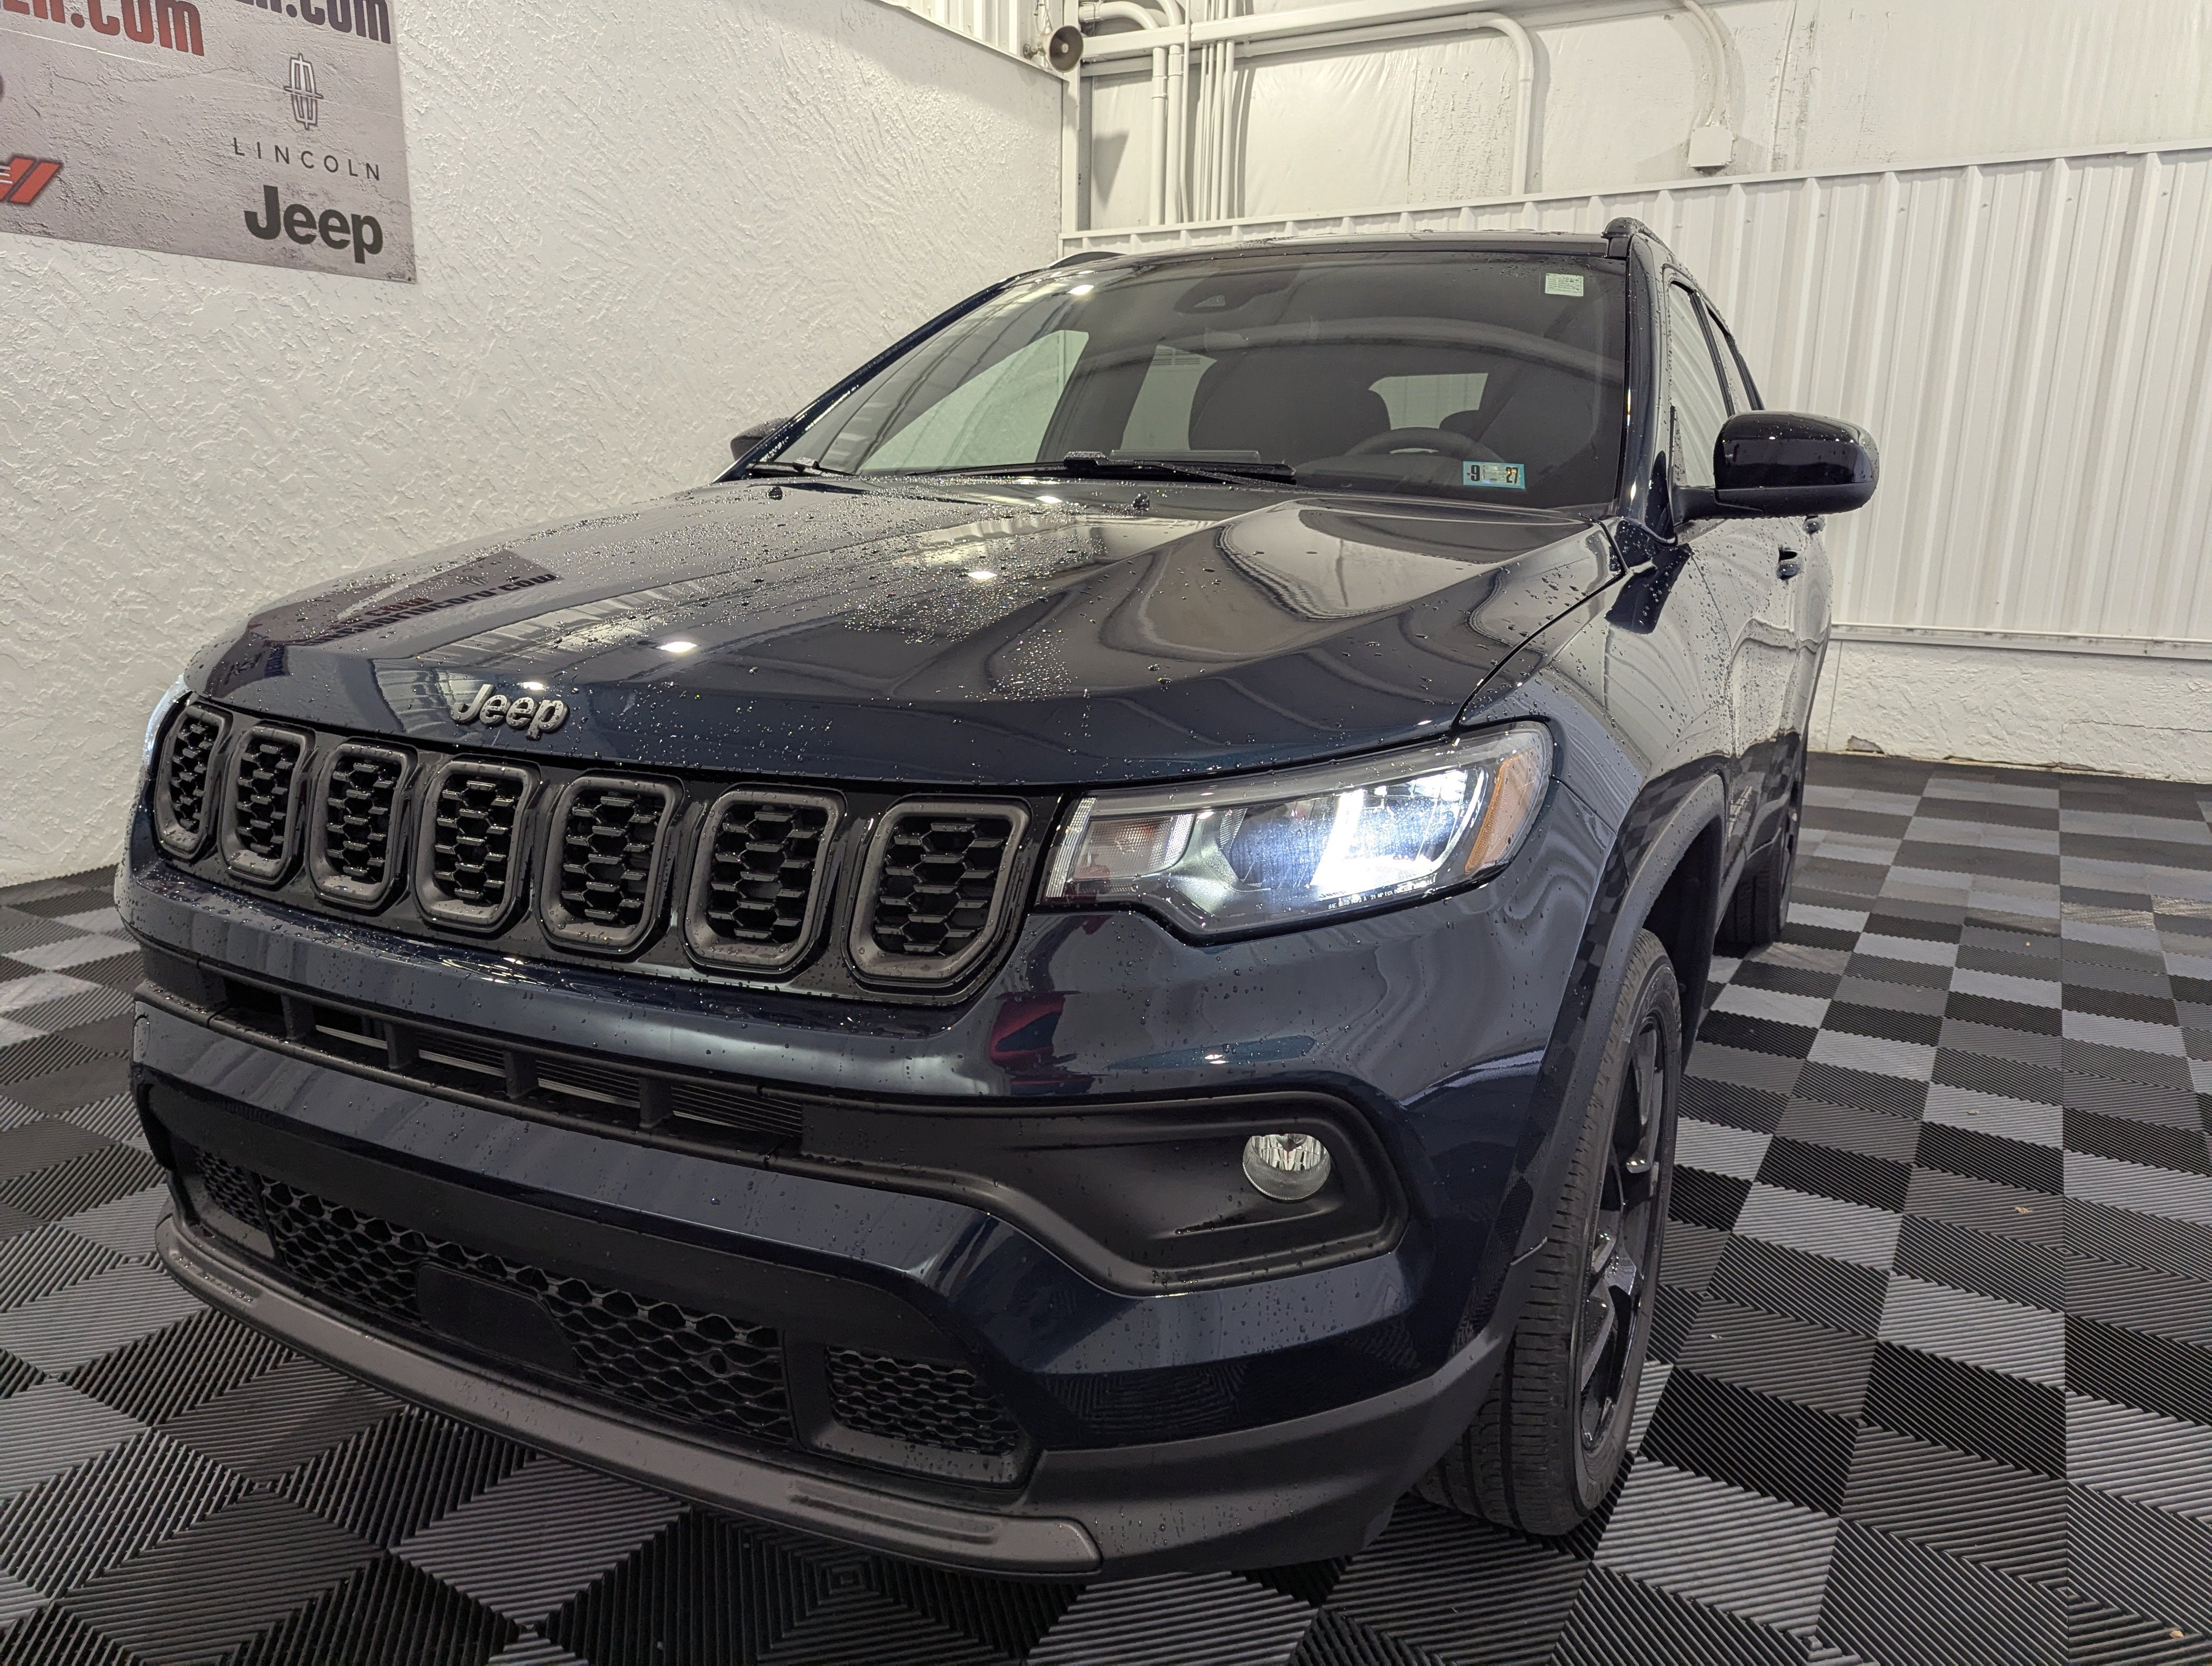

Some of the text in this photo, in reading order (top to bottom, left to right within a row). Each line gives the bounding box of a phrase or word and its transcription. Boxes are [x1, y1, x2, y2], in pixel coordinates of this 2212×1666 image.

[233, 137, 380, 181] LINCOLN
[244, 184, 383, 264] Jeep
[1471, 465, 1480, 482] 9
[1506, 467, 1519, 484] 27
[451, 684, 569, 741] Jeep
